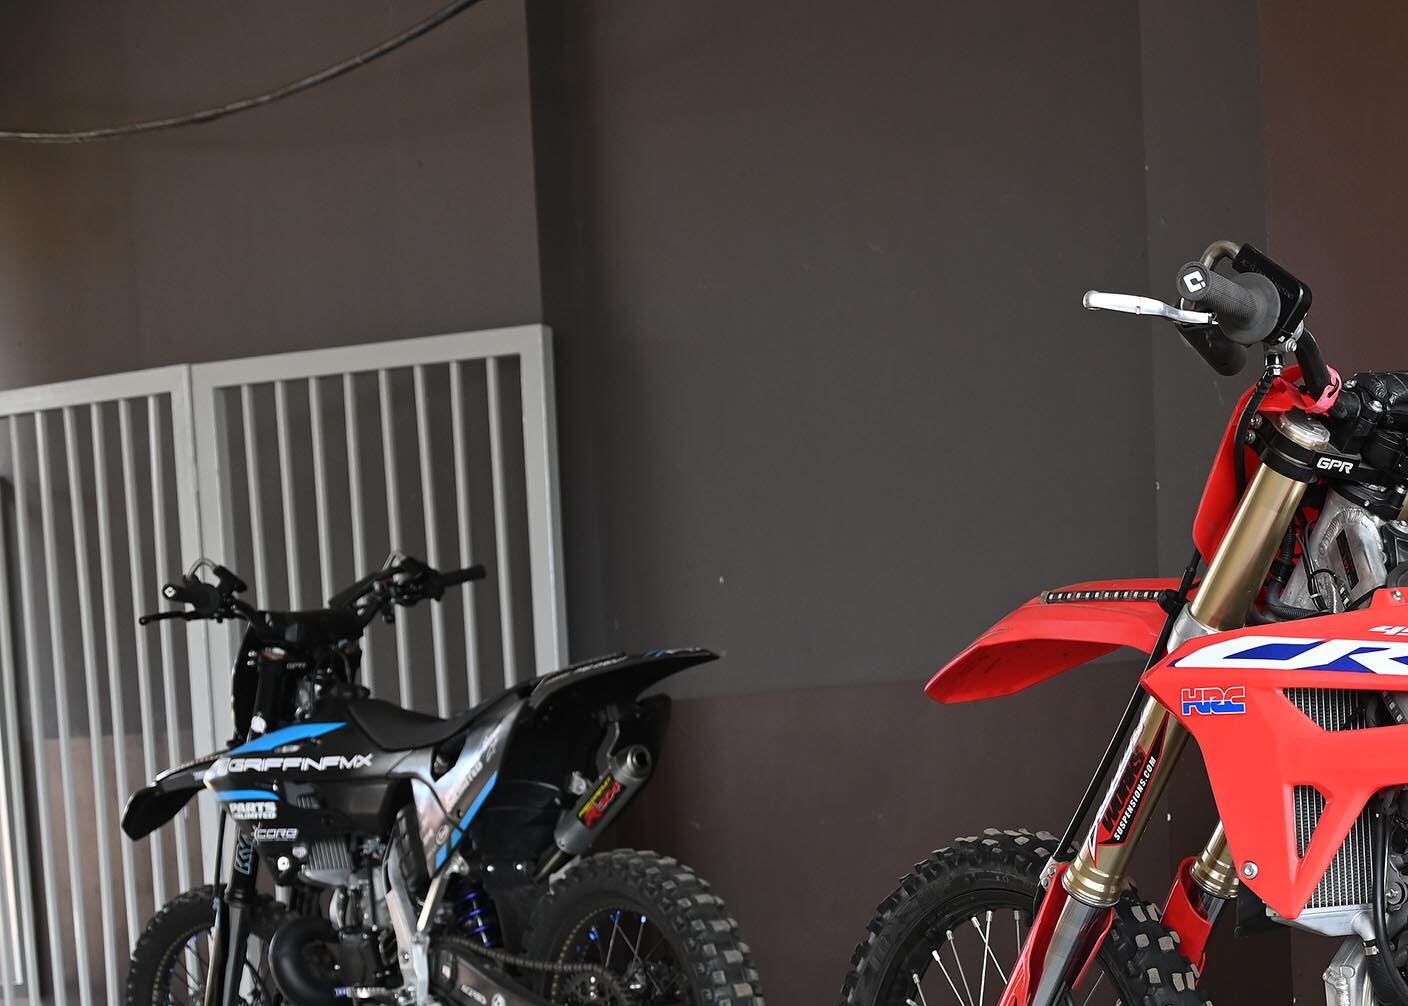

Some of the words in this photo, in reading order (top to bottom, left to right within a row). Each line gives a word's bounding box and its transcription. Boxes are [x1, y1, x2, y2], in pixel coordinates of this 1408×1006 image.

[1316, 457, 1354, 474] GPR
[1181, 686, 1247, 716] HRC
[228, 753, 374, 772] GRIFFINFMX
[229, 801, 277, 813] PARTS
[1113, 756, 1157, 841] SUSPENSIONS.COM
